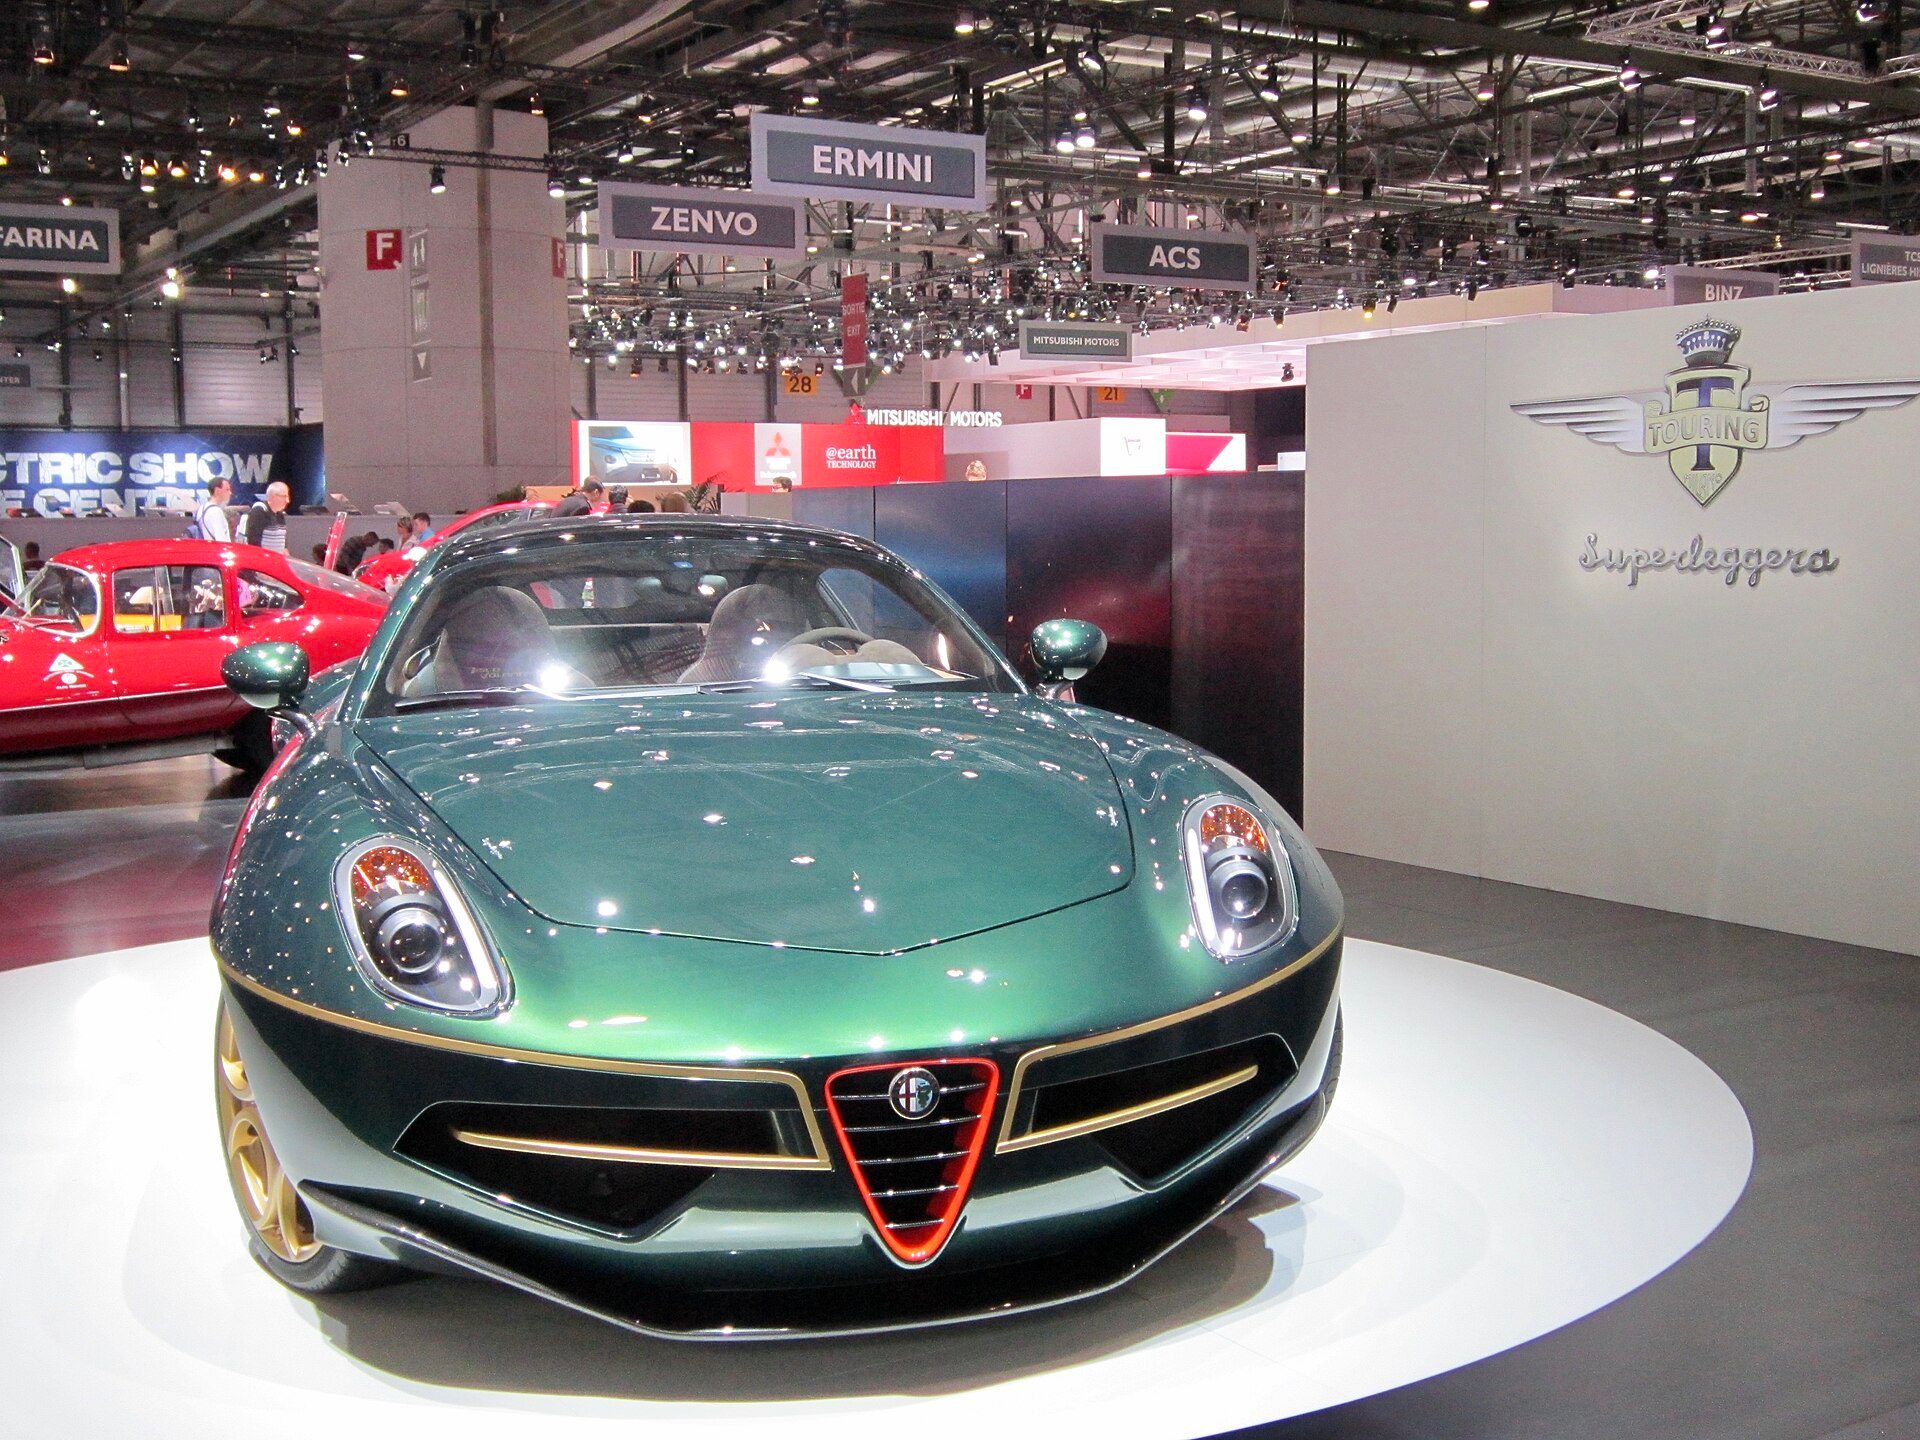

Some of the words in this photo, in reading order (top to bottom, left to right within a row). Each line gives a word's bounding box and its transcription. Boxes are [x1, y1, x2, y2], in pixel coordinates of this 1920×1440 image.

[813, 145, 932, 183] ERMINI
[651, 206, 758, 236] ZENVO
[376, 232, 395, 260] F
[1149, 244, 1201, 270] ACS
[1033, 336, 1083, 346] MITSUBISHI
[1084, 338, 1120, 347] MOTORS
[789, 376, 812, 393] 28
[1104, 386, 1119, 401] 21
[866, 409, 944, 426] MITSUBISHI
[949, 411, 1003, 427] MOTORS
[1648, 414, 1761, 447] TOURING
[825, 443, 877, 461] @earth
[826, 460, 877, 469] TECHNOLOGY
[0, 452, 123, 485] TRIC
[129, 451, 273, 485] SHOW
[1579, 533, 1840, 588] Superleggera
